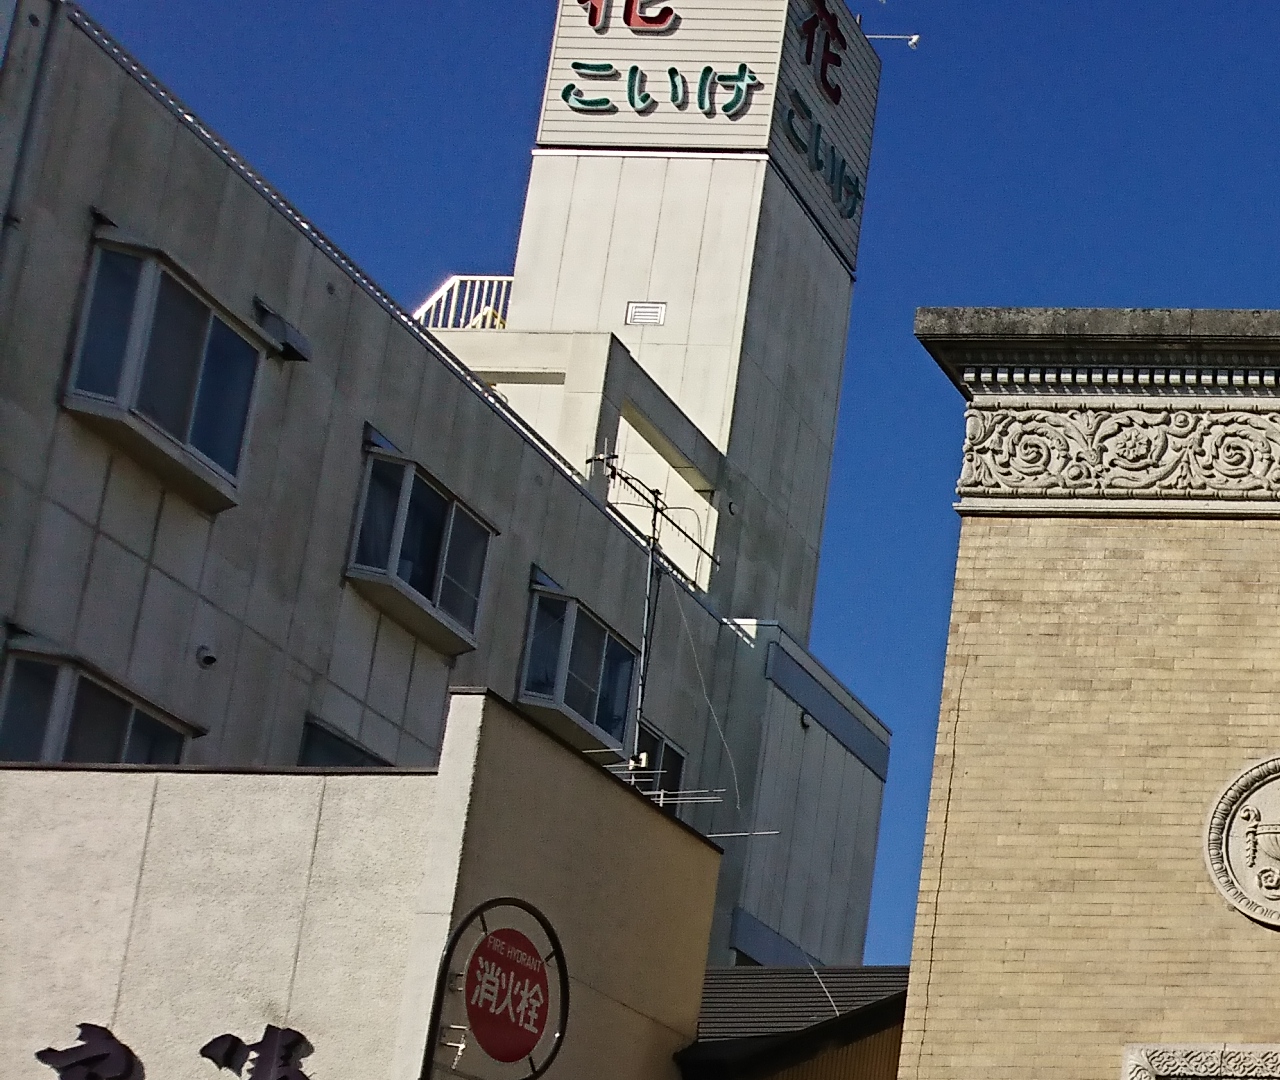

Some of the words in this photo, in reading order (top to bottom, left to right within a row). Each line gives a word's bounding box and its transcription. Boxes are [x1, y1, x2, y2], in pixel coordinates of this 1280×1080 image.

[561, 62, 762, 117] こいけ
[781, 89, 863, 219] こいけ
[487, 935, 505, 955] FIRE
[507, 944, 542, 973] HYDRANT
[471, 956, 544, 1034] 消火栓
